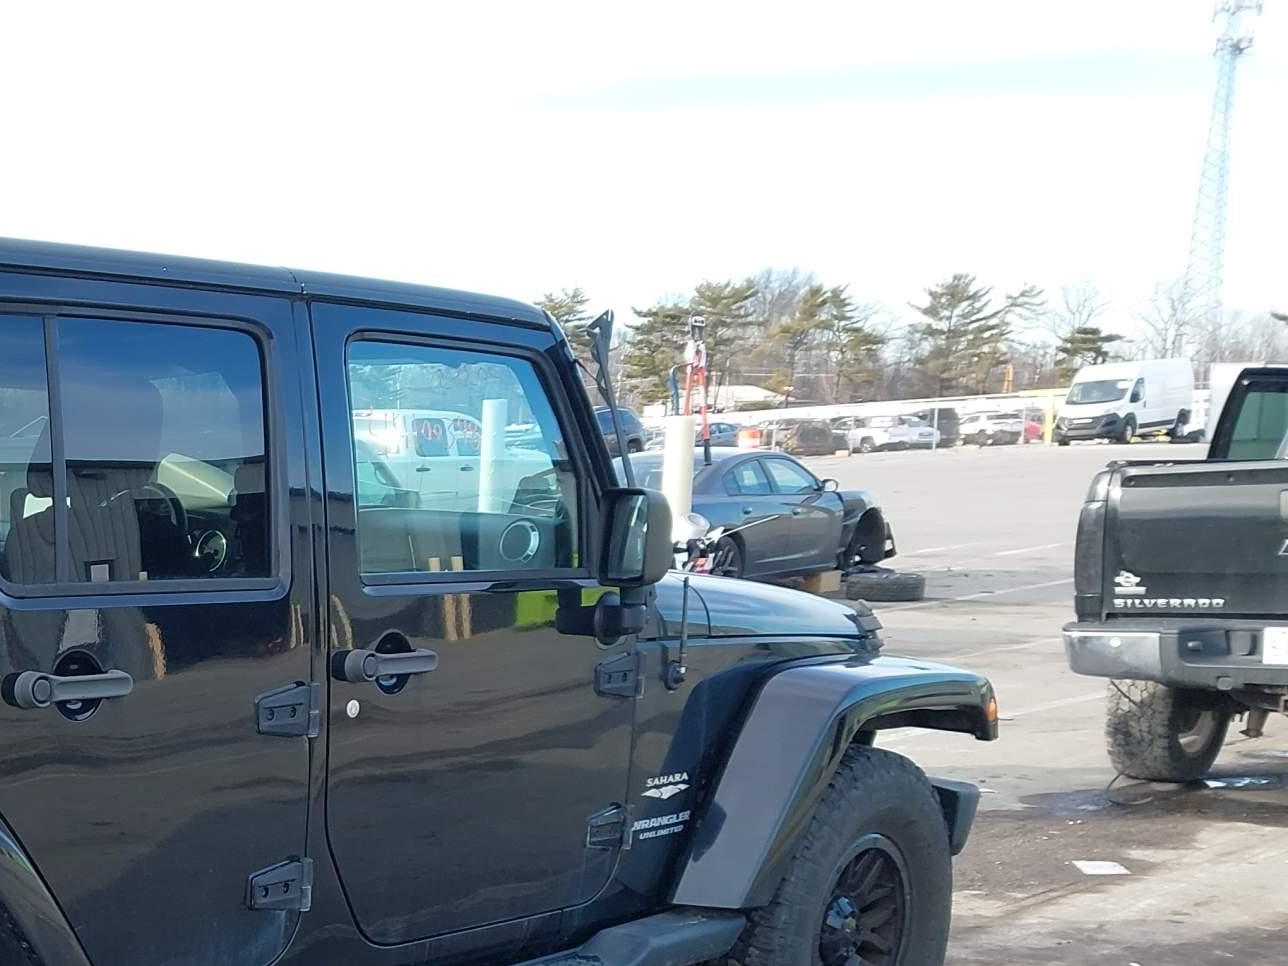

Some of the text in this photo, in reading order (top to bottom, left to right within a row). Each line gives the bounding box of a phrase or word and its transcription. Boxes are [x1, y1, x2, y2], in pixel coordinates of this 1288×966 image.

[1113, 599, 1225, 608] SILVERADO
[646, 772, 689, 788] SAHARA
[632, 810, 690, 831] WRANGLER
[639, 824, 684, 840] UNLIMITED
